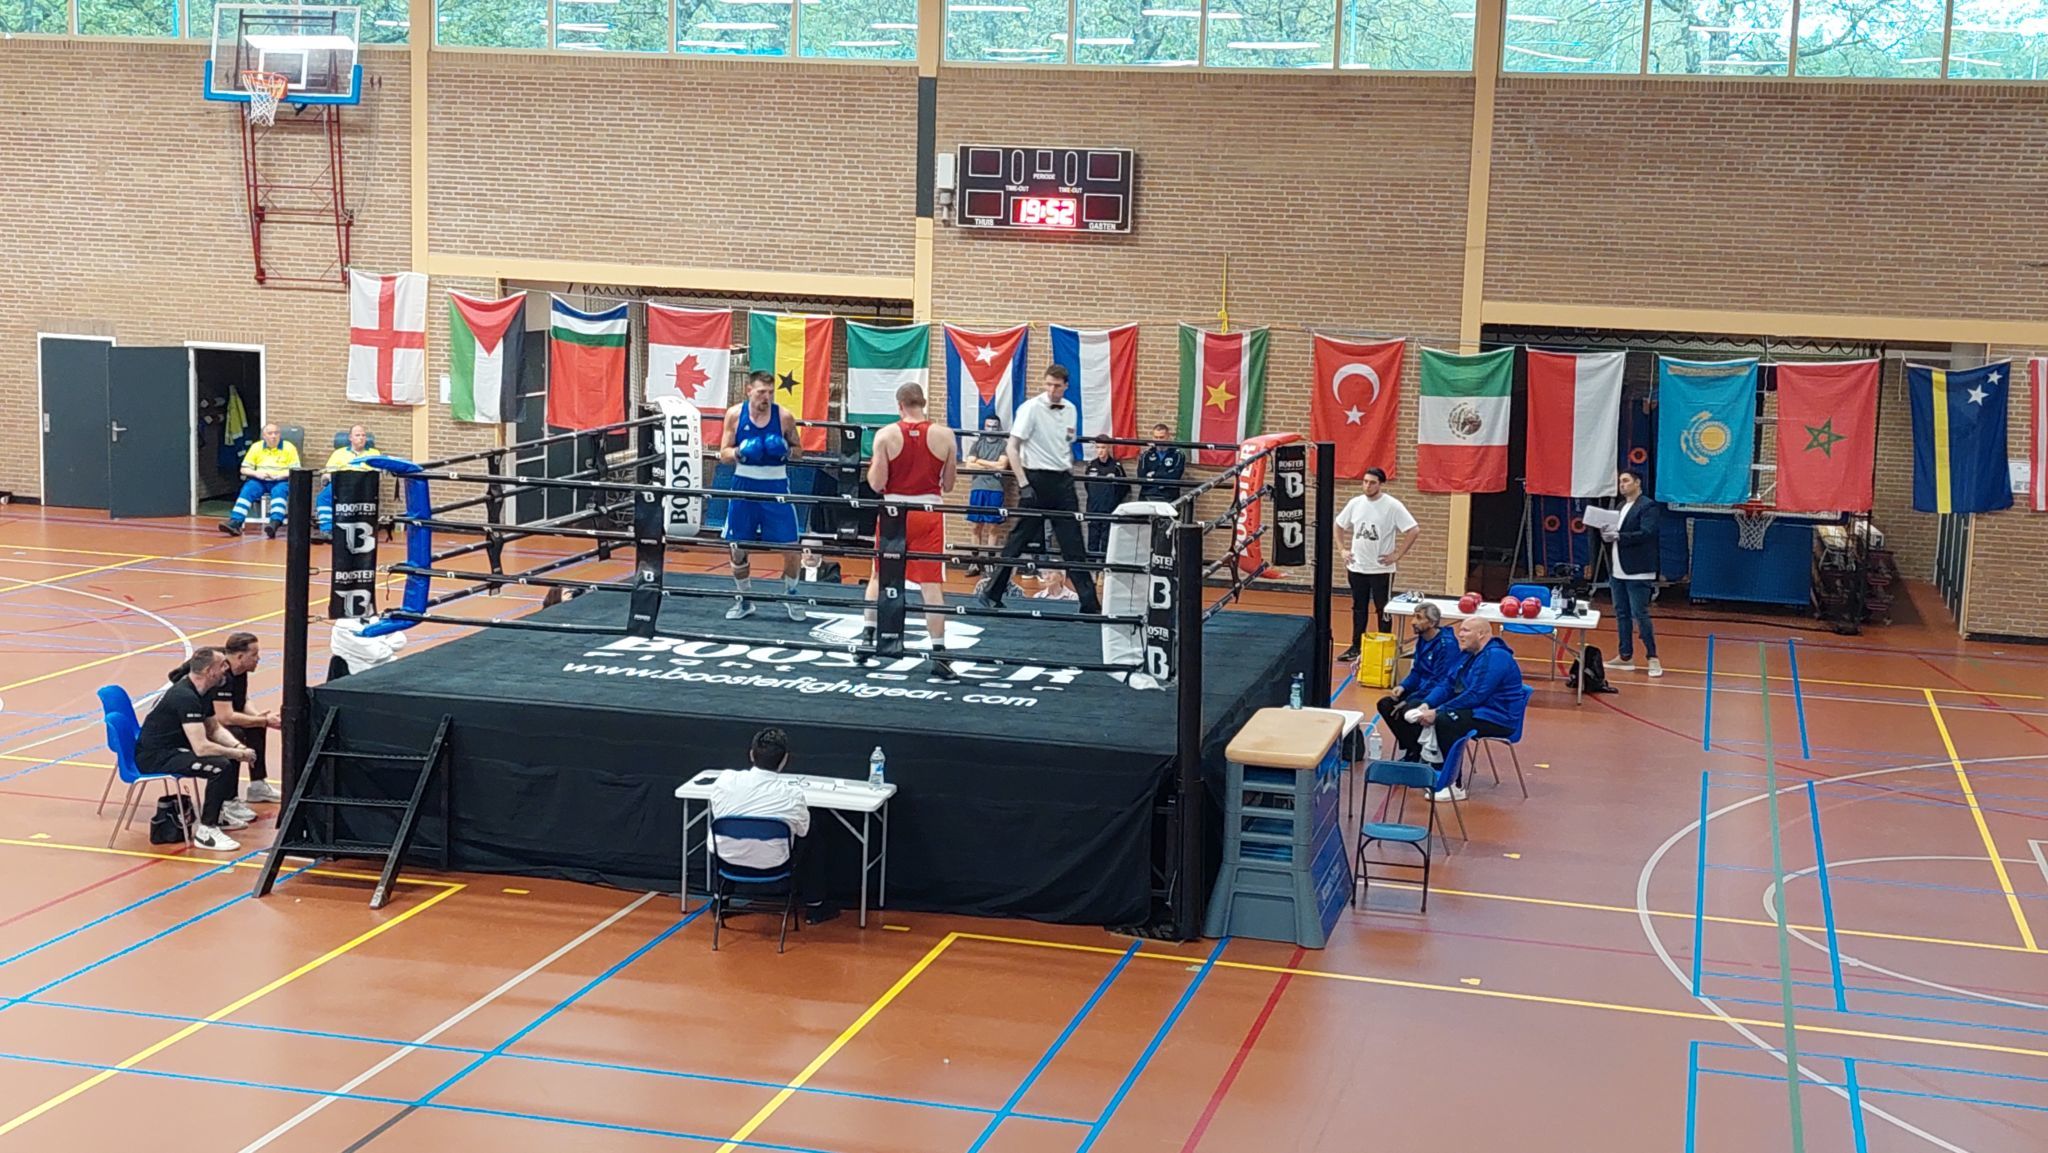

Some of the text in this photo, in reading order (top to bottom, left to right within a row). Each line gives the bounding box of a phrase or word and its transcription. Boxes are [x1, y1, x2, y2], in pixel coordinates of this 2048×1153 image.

[1020, 199, 1075, 224] 19:52
[975, 218, 994, 226] THUIS
[1089, 222, 1116, 231] GASTEN
[670, 415, 690, 524] BOOSTER
[335, 503, 376, 513] BOOSTER
